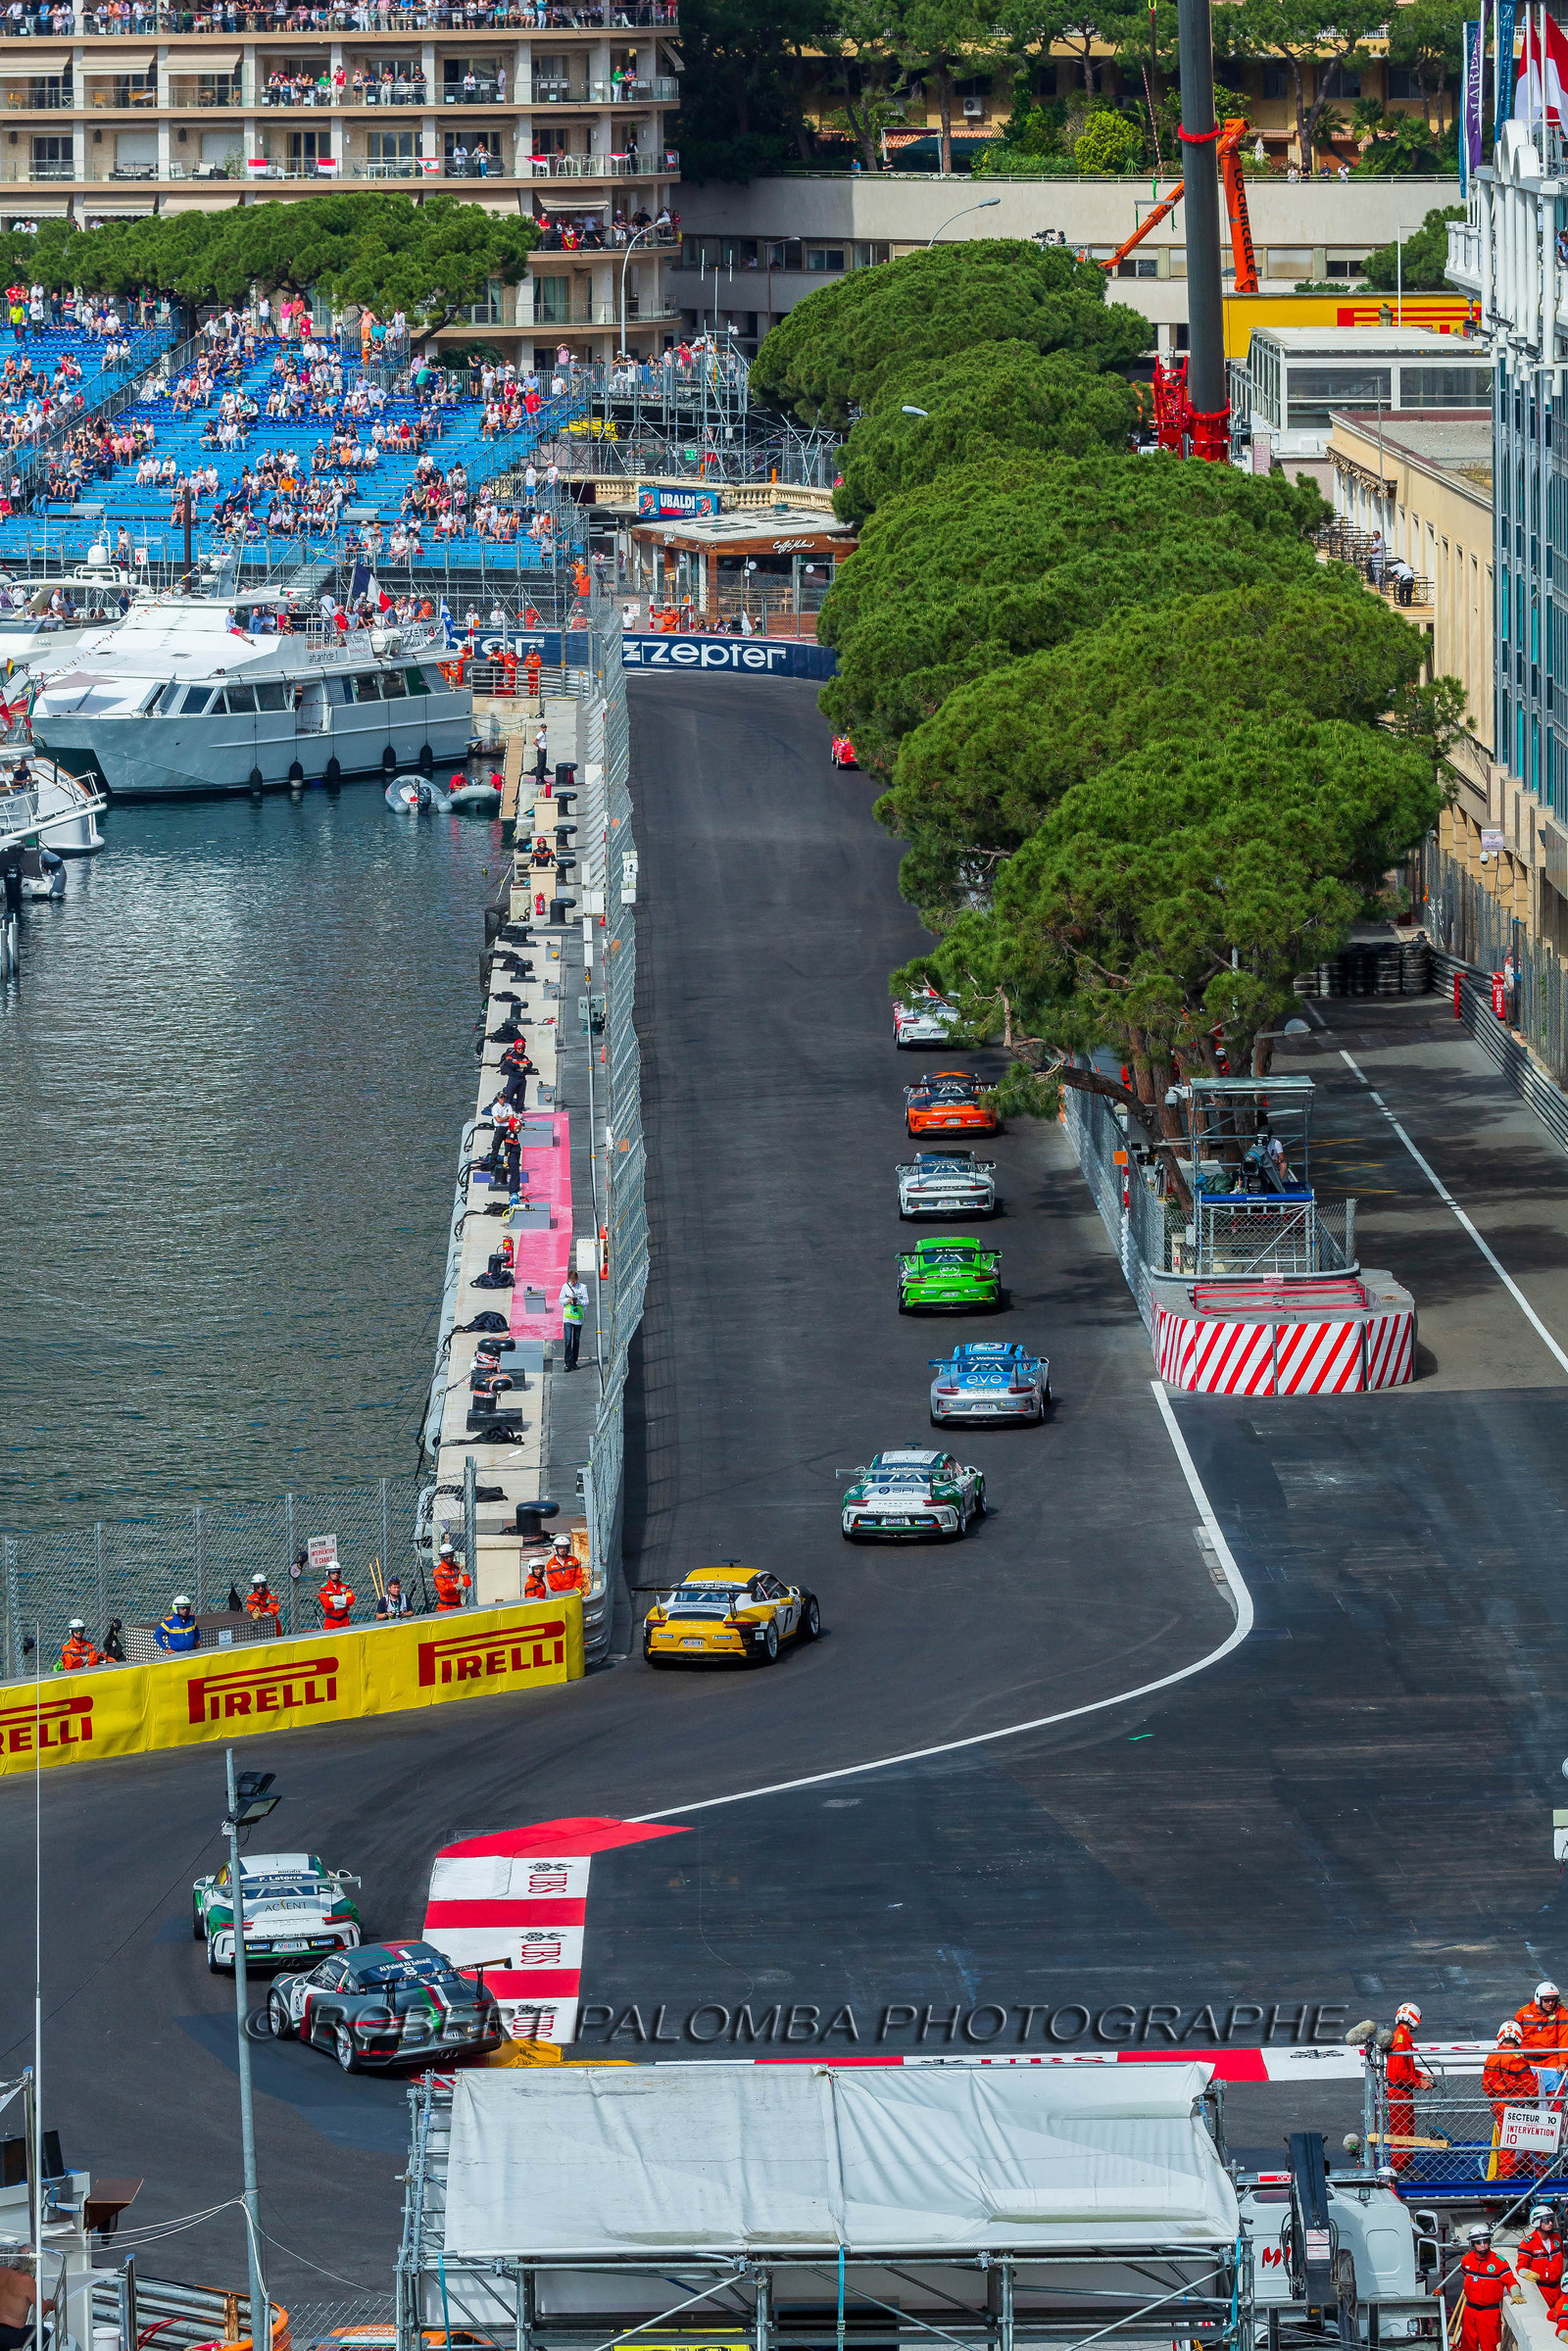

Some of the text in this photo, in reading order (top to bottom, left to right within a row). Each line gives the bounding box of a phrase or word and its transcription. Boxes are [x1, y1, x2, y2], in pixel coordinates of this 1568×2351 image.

[660, 493, 695, 509] UBALDI
[643, 641, 785, 669] zepter
[966, 1375, 1002, 1384] eve
[418, 1620, 564, 1687] PIRELLI
[188, 1656, 339, 1725] PIRELLI
[527, 1873, 567, 1893] UBS
[520, 1941, 561, 1965] UBS
[399, 1965, 476, 1983] LECHNER RACING
[403, 1966, 417, 1976] 8
[512, 2015, 555, 2039] UBS
[1506, 2025, 1513, 2033] S
[1507, 2112, 1557, 2125] SECTEUR 10
[1506, 2133, 1518, 2145] 10
[1507, 2125, 1555, 2137] INTERVENTION
